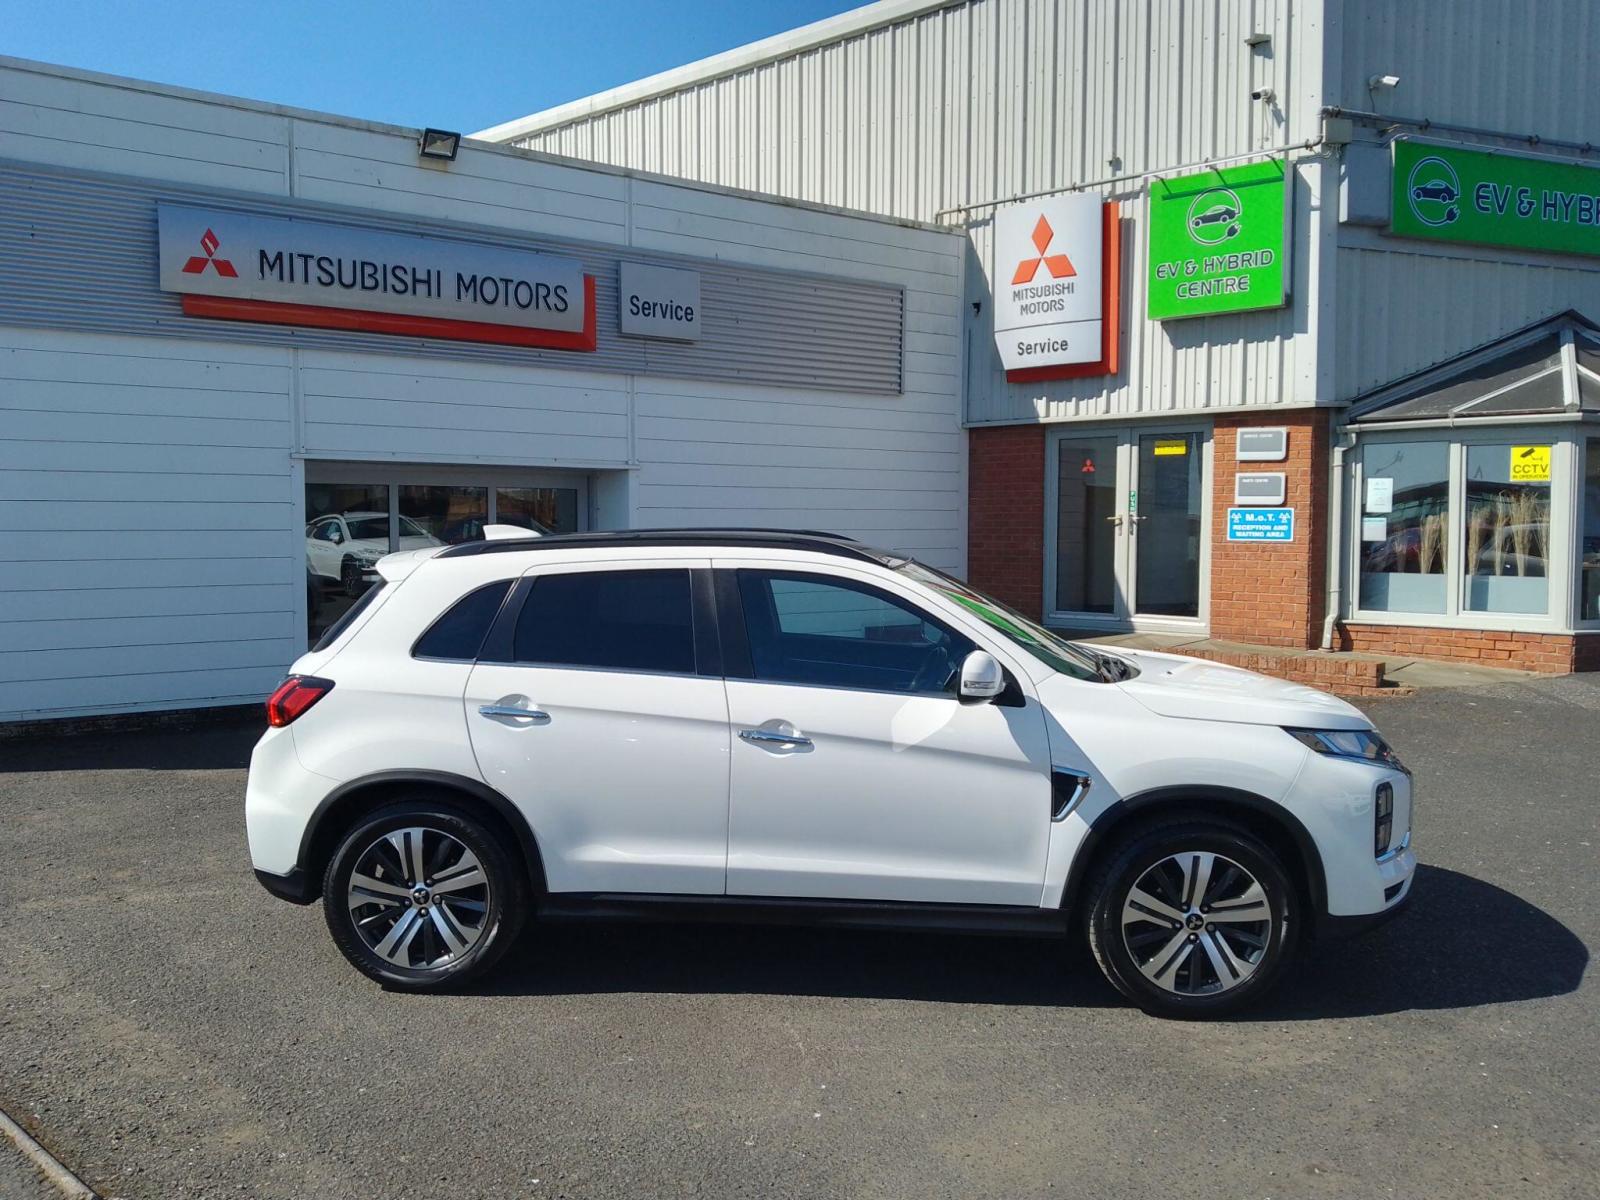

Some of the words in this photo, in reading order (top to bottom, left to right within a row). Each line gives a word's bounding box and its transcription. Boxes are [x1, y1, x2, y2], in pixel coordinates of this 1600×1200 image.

[1474, 181, 1512, 215] EV
[1516, 186, 1536, 218] &
[1156, 260, 1181, 279] EV
[1185, 258, 1199, 276] &
[1203, 249, 1274, 274] HYBRID
[258, 248, 442, 299] MITSUBISHI
[455, 272, 569, 313] MOTORS
[1012, 282, 1075, 302] MITSUBISHI
[1176, 274, 1250, 300] CENTRE
[629, 294, 694, 323] Service
[1020, 298, 1065, 316] MOTORS
[1017, 337, 1069, 356] Service
[1513, 463, 1549, 474] CCTV
